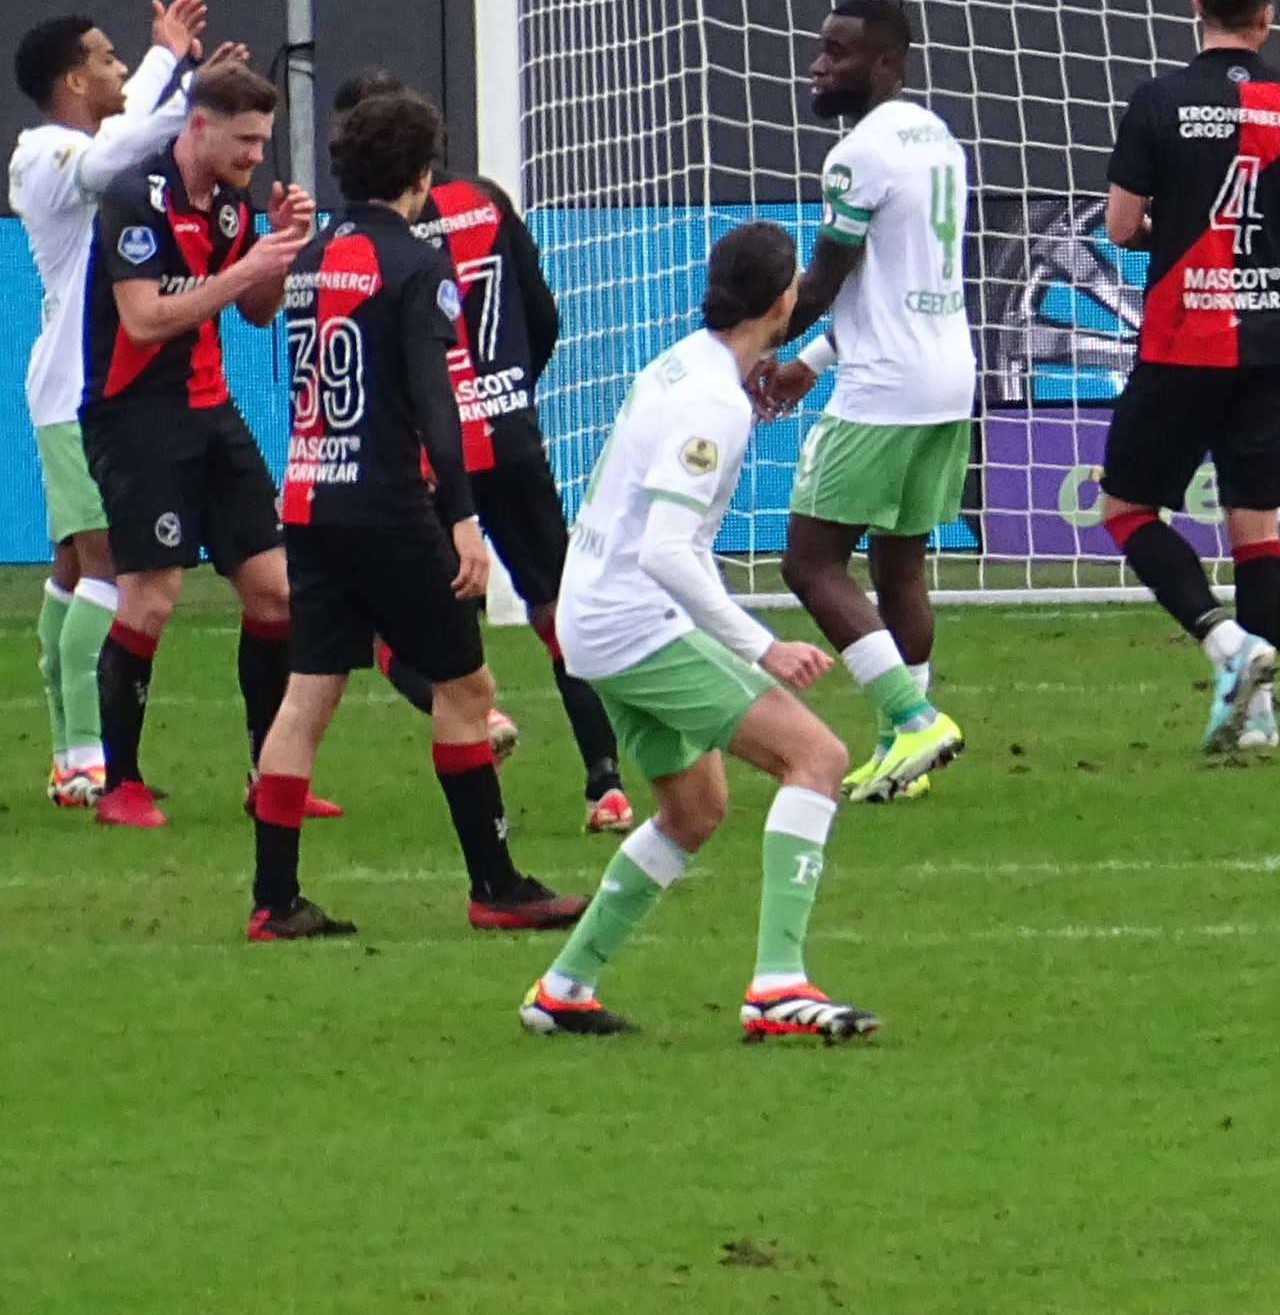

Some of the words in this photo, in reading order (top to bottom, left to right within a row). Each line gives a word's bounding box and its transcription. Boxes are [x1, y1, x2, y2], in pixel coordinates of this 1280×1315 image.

[1179, 122, 1235, 138] GROEP
[930, 165, 959, 279] 4
[1208, 155, 1264, 255] 4
[1183, 291, 1280, 310] WORKWEAR
[287, 316, 365, 429] 39
[459, 389, 529, 425] RKWEAR
